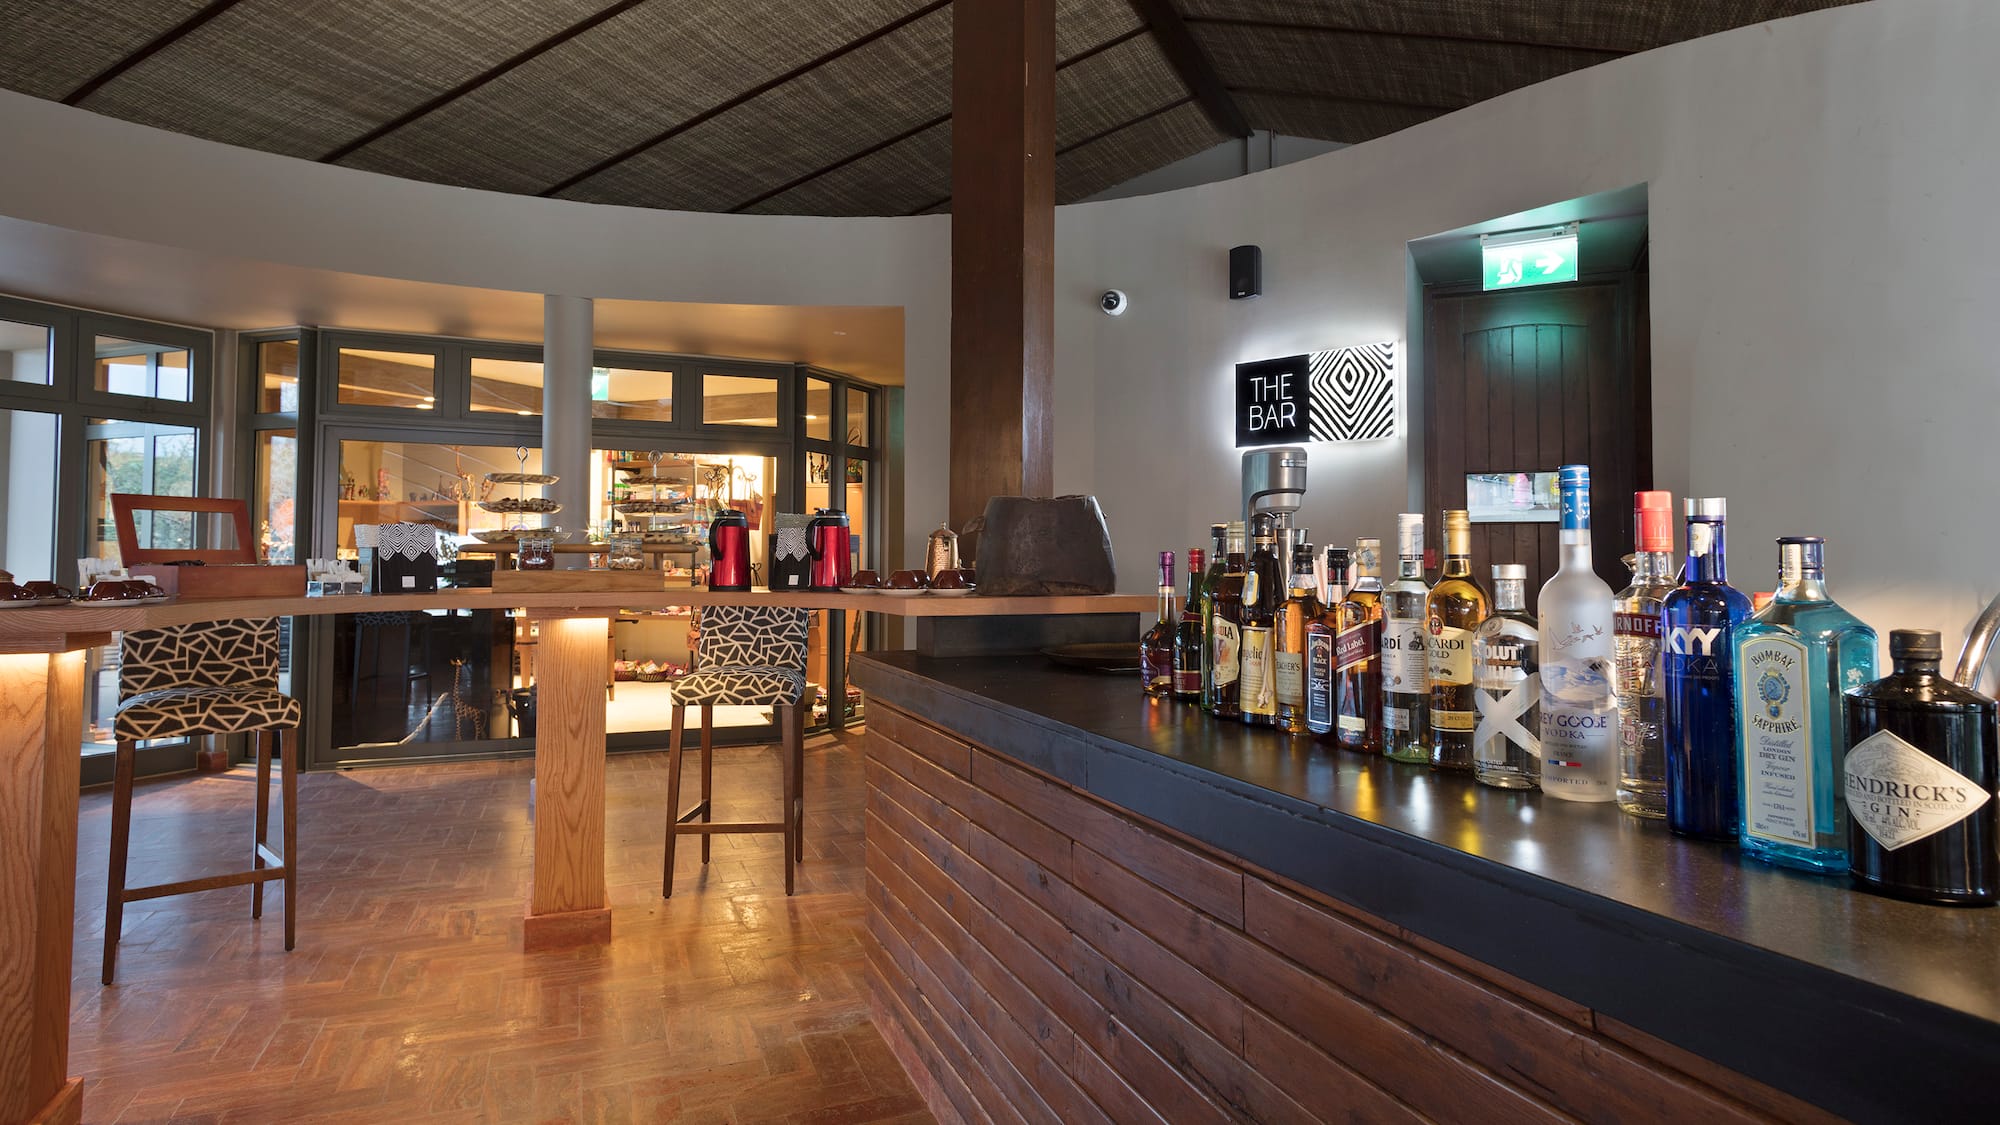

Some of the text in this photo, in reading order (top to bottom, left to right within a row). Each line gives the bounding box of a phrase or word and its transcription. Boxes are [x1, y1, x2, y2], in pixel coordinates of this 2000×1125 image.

[1250, 373, 1293, 402] THE
[1249, 402, 1296, 431] BAR
[1336, 644, 1348, 656] Red
[1347, 636, 1366, 652] Label
[1750, 650, 1796, 672] BOMBAY
[1557, 714, 1607, 729] GOOSE
[1752, 714, 1799, 734] SAPPHIRE
[1545, 727, 1586, 740] VODKA
[1759, 751, 1796, 762] DRY GIN
[1870, 803, 1909, 818] GIN
